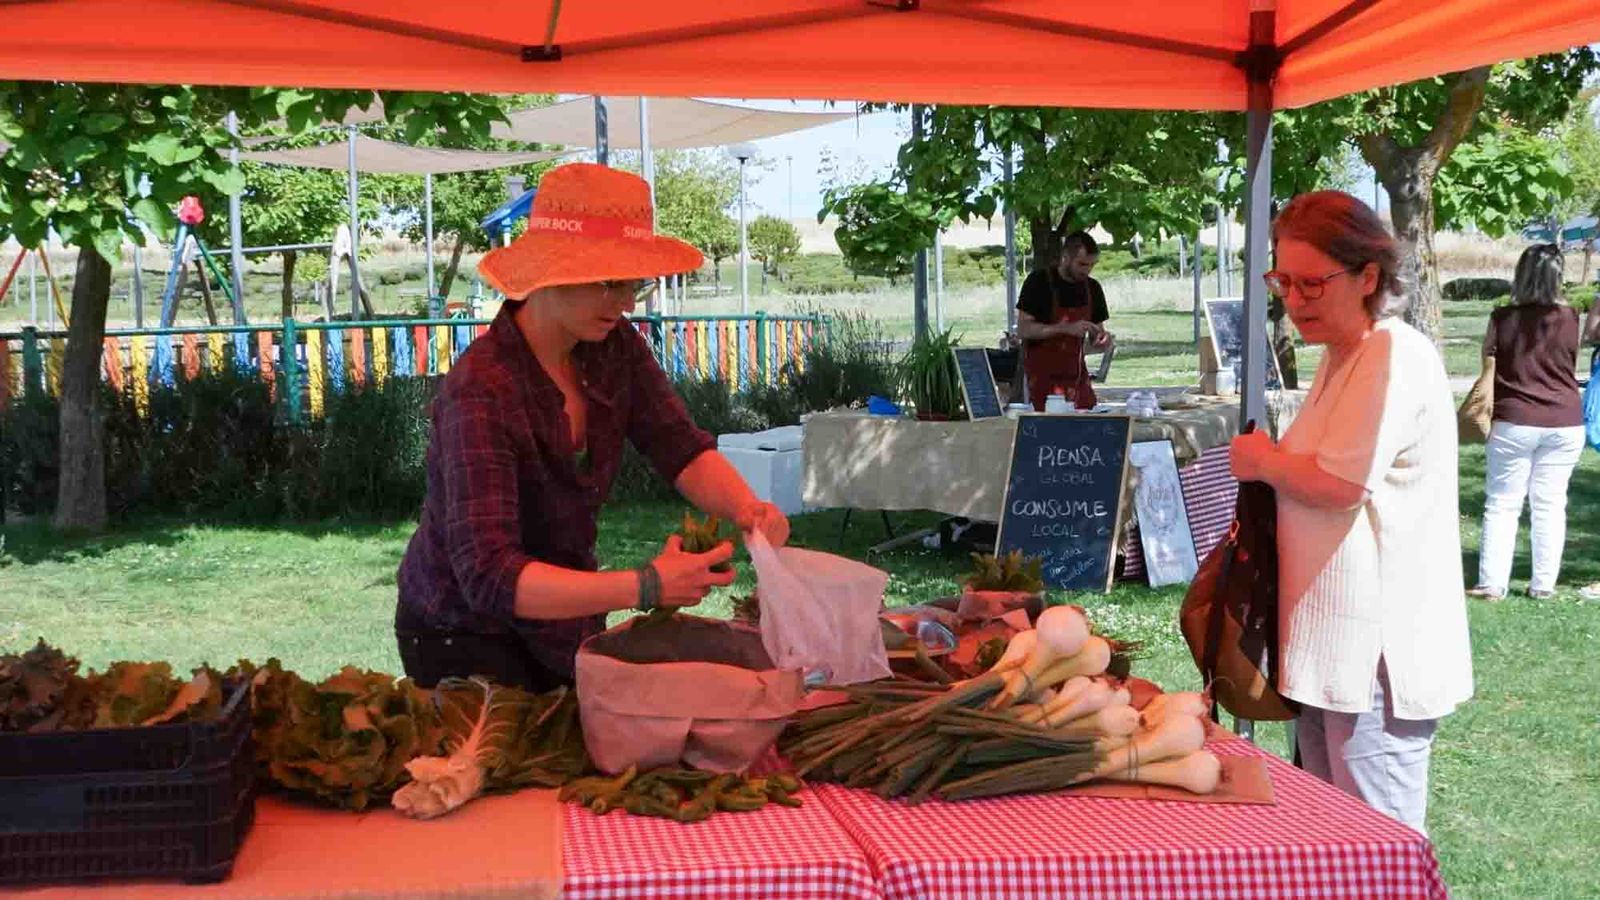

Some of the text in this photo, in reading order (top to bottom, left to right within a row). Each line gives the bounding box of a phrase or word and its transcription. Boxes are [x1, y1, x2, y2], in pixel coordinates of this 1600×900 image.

[553, 218, 583, 233] BOCK
[1012, 499, 1108, 519] CONSUME
[1032, 523, 1080, 538] LOCAL
